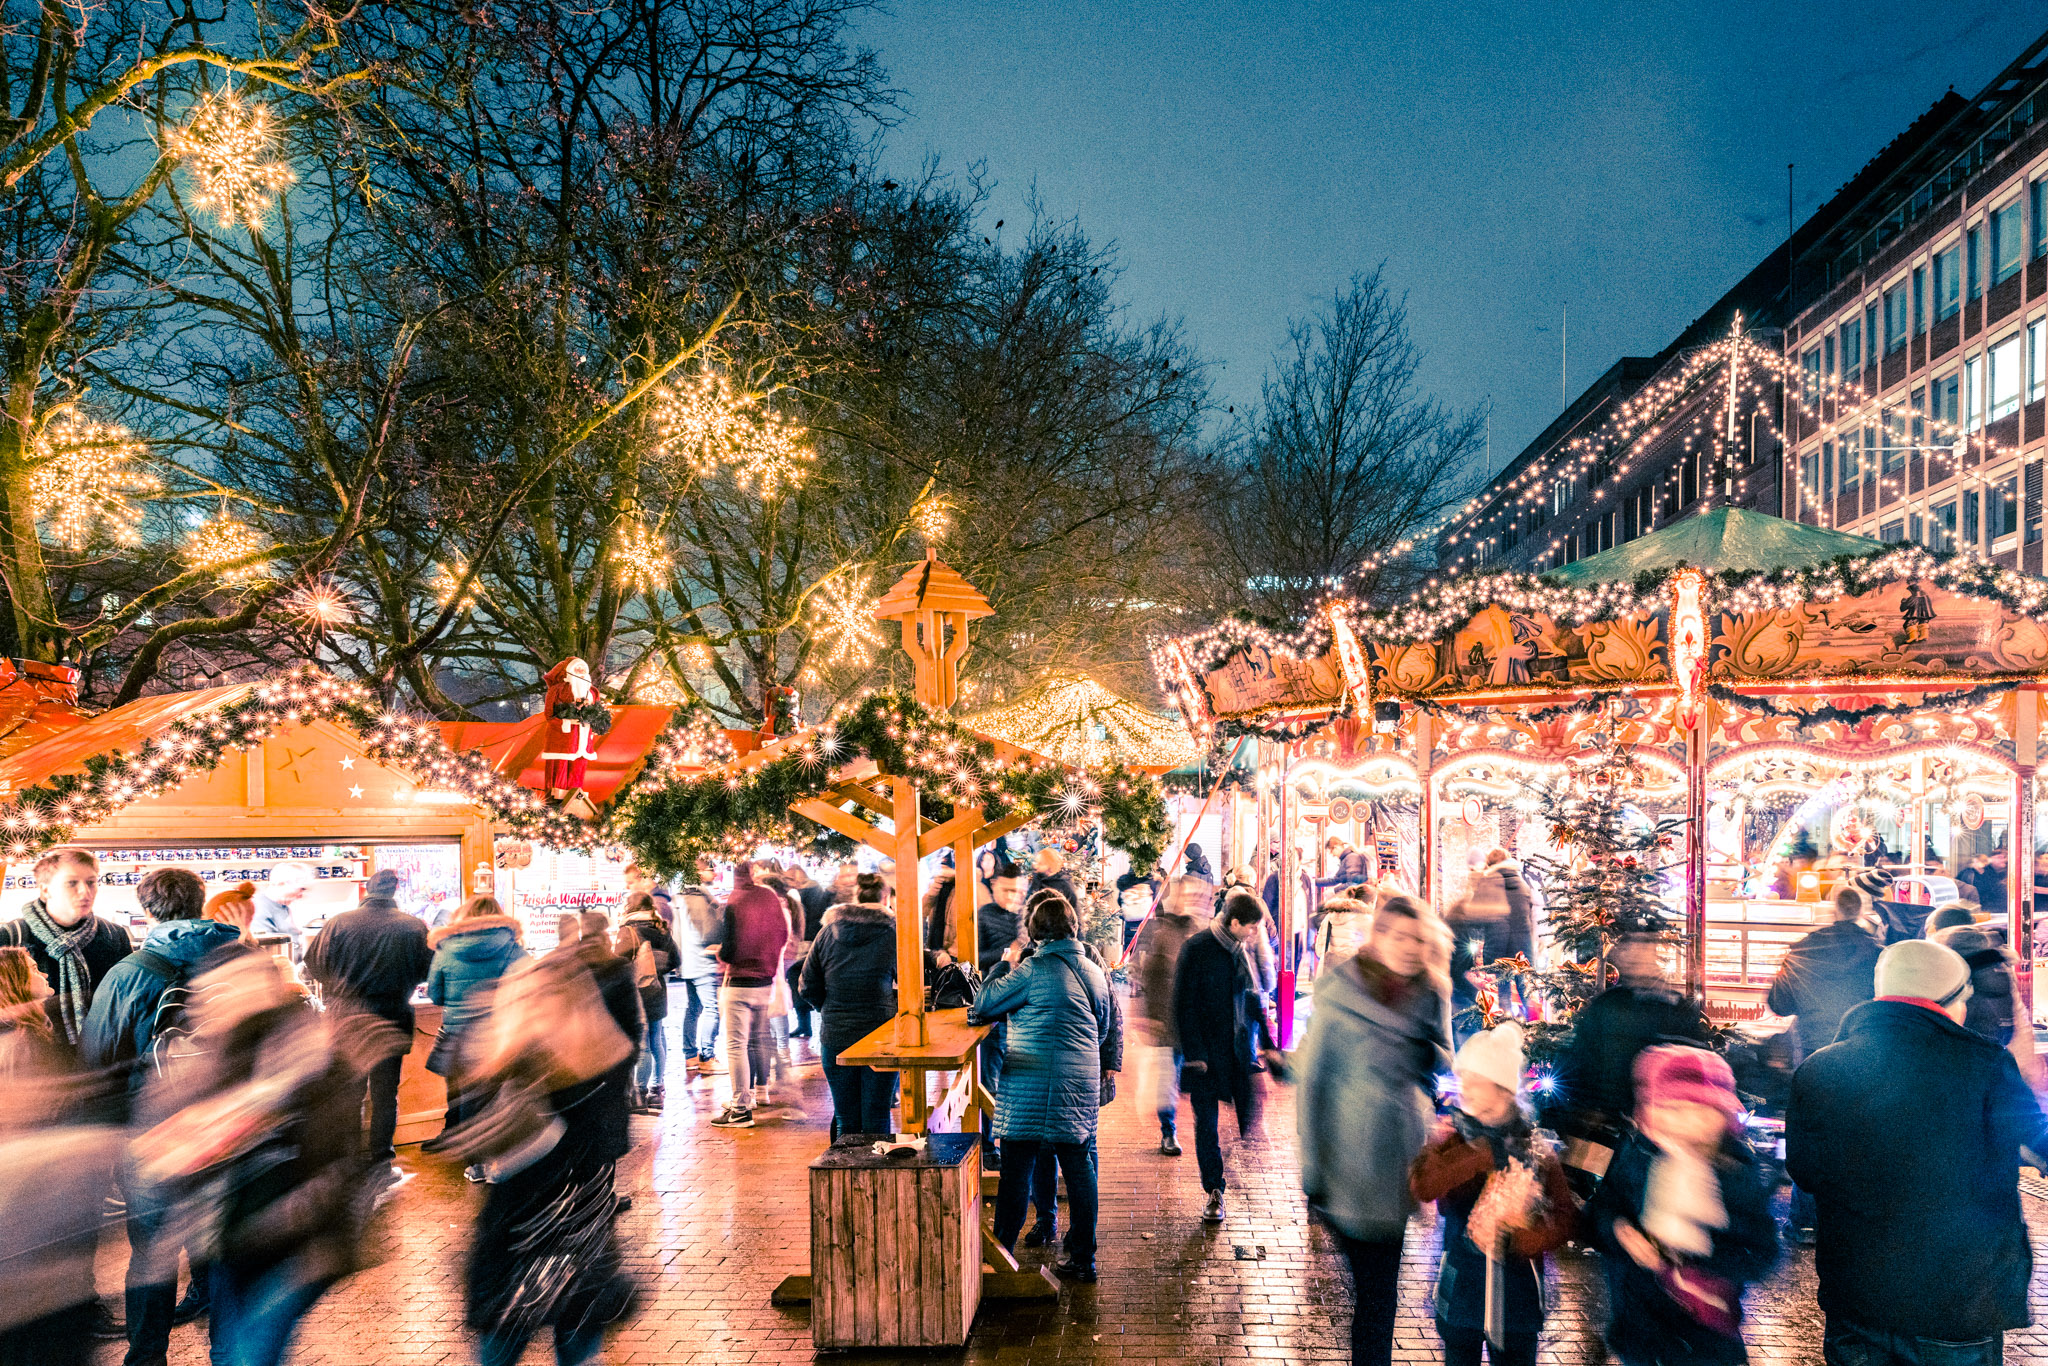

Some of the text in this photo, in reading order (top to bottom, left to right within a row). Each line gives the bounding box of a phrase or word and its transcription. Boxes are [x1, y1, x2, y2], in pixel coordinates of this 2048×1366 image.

[522, 893, 557, 906] Frische
[560, 892, 602, 907] Waffeln
[1706, 1000, 1766, 1020] ihnachtsmarkt
